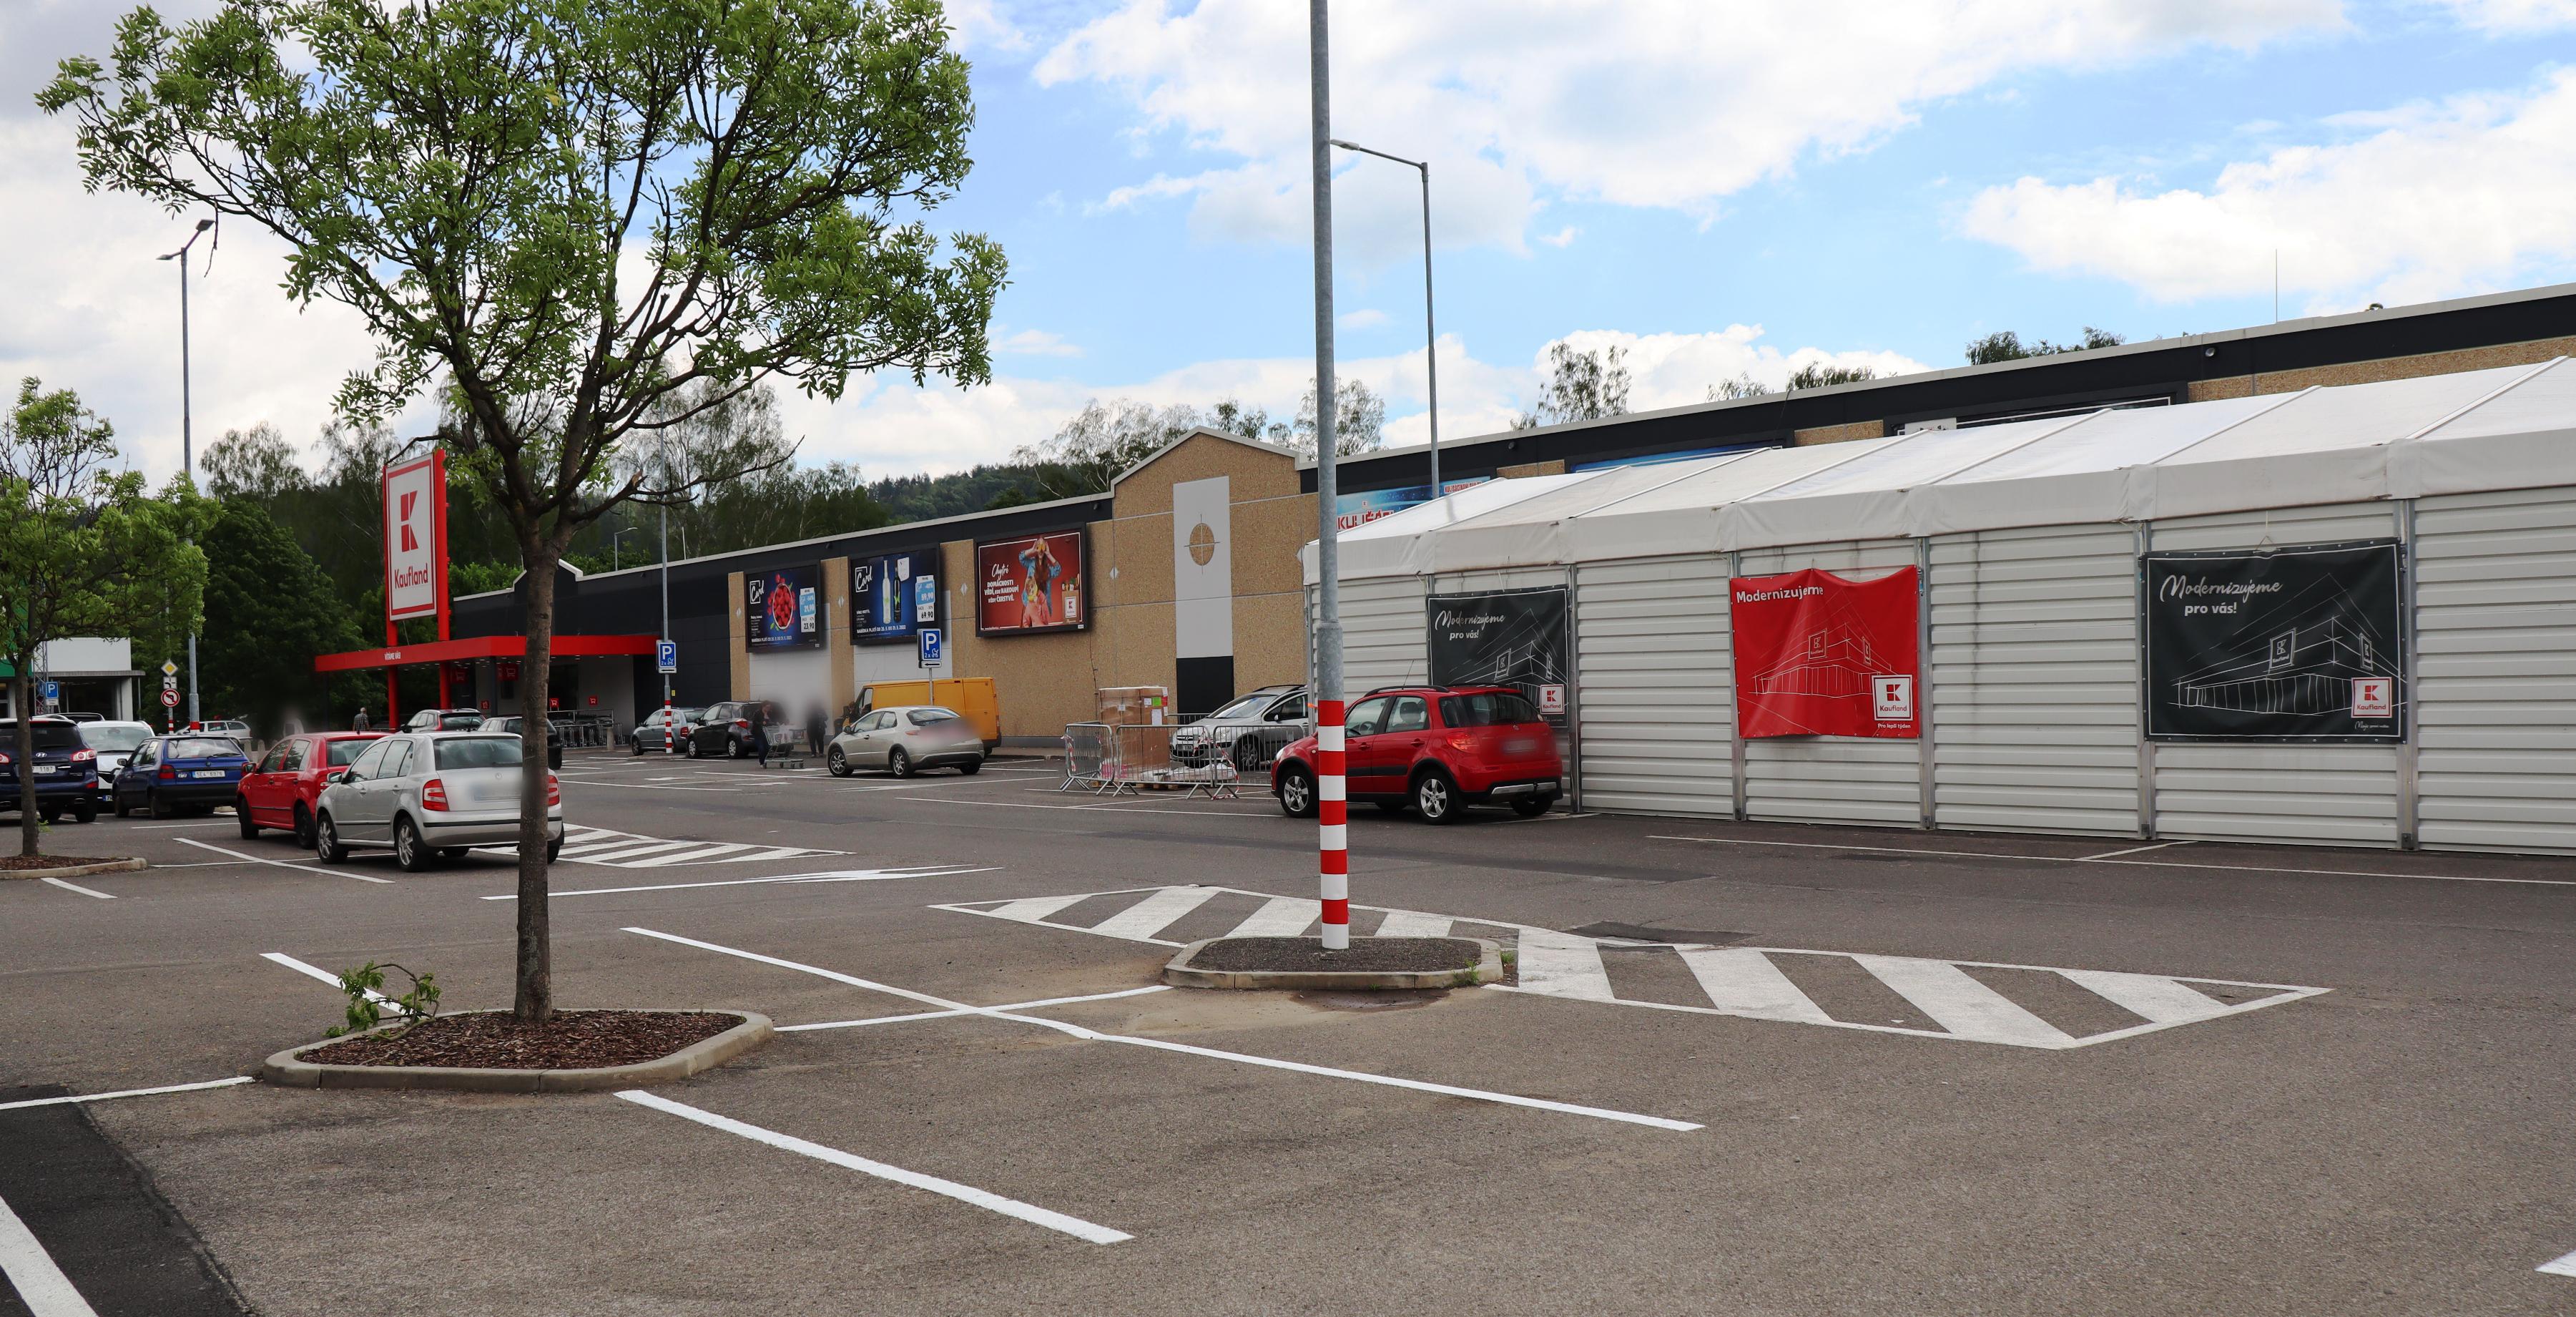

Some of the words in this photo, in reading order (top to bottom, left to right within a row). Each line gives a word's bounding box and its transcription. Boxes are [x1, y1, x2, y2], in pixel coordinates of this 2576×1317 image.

[394, 563, 428, 589] Kaufland
[857, 566, 872, 589] Card
[751, 579, 764, 602] Card
[1736, 585, 1824, 603] Modernizujeme
[2159, 574, 2283, 603] Modernizujeme
[2184, 604, 2208, 616] pro
[2212, 602, 2237, 615] vás!
[1435, 610, 1505, 631] Modernizujeme
[925, 632, 937, 651] P
[1450, 632, 1464, 641] pro
[1466, 630, 1479, 639] vás!
[662, 645, 672, 660] P
[48, 684, 56, 694] P
